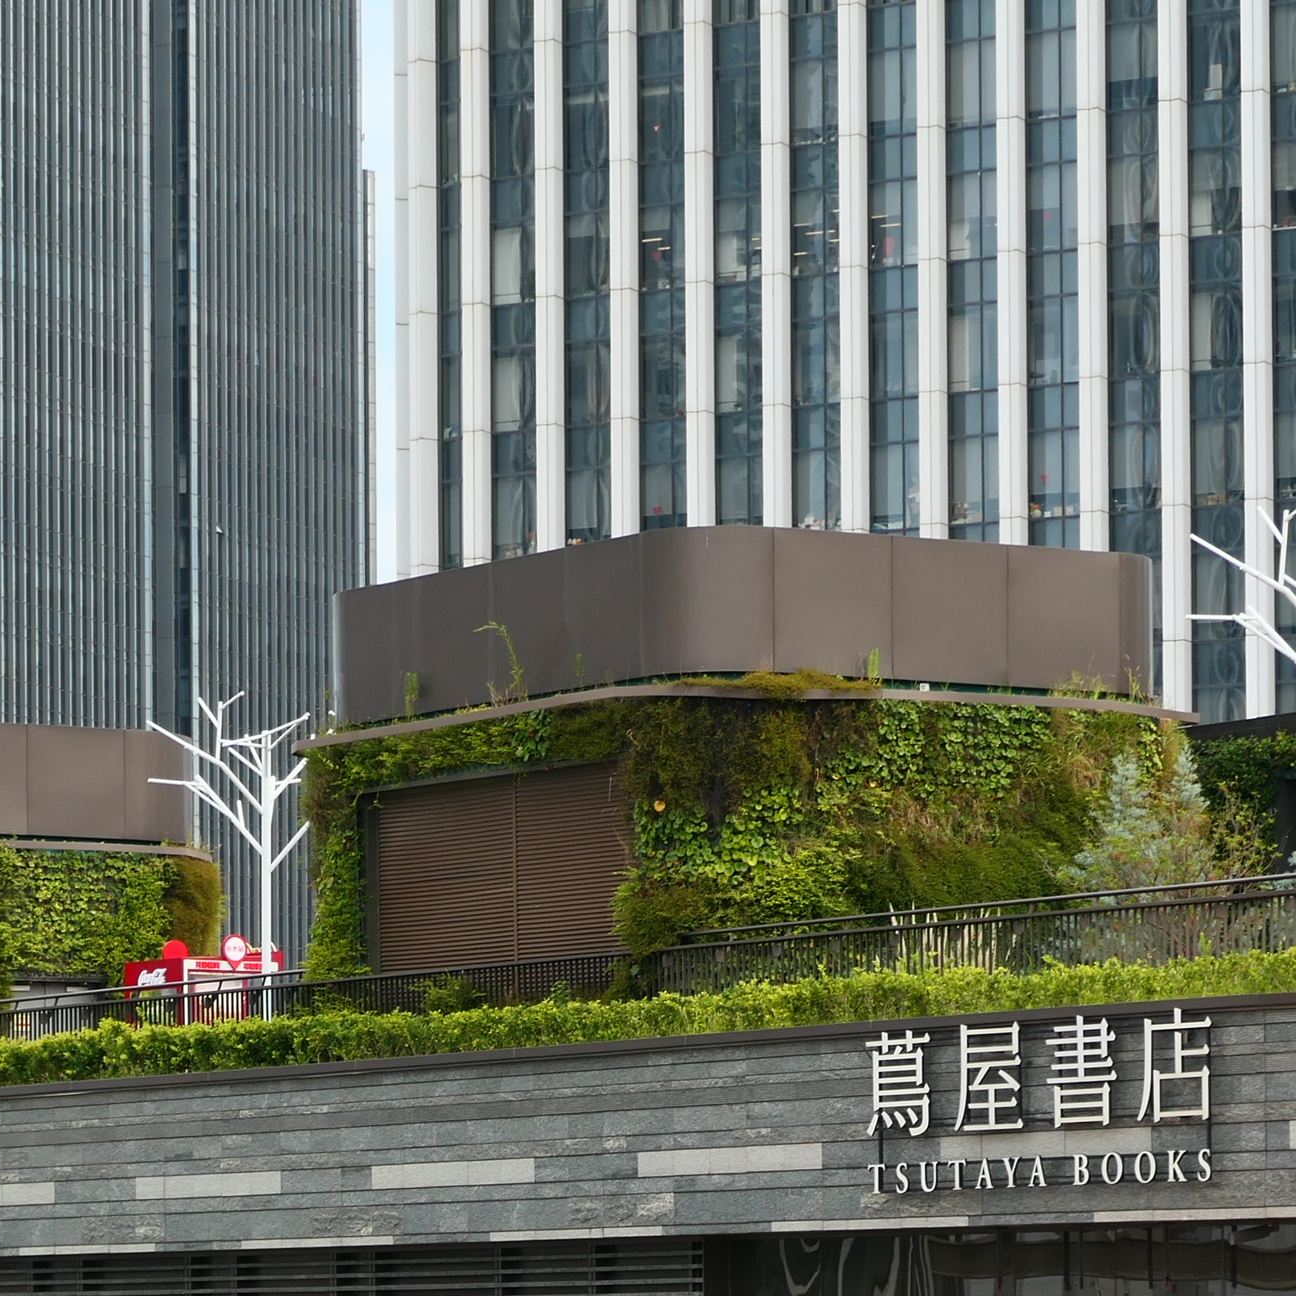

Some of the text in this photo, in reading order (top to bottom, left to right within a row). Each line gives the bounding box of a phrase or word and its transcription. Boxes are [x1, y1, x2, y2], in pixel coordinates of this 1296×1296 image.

[865, 1007, 1212, 1137] 蔦屋書店
[867, 1148, 1212, 1195] TSUTAYA BOOKS
